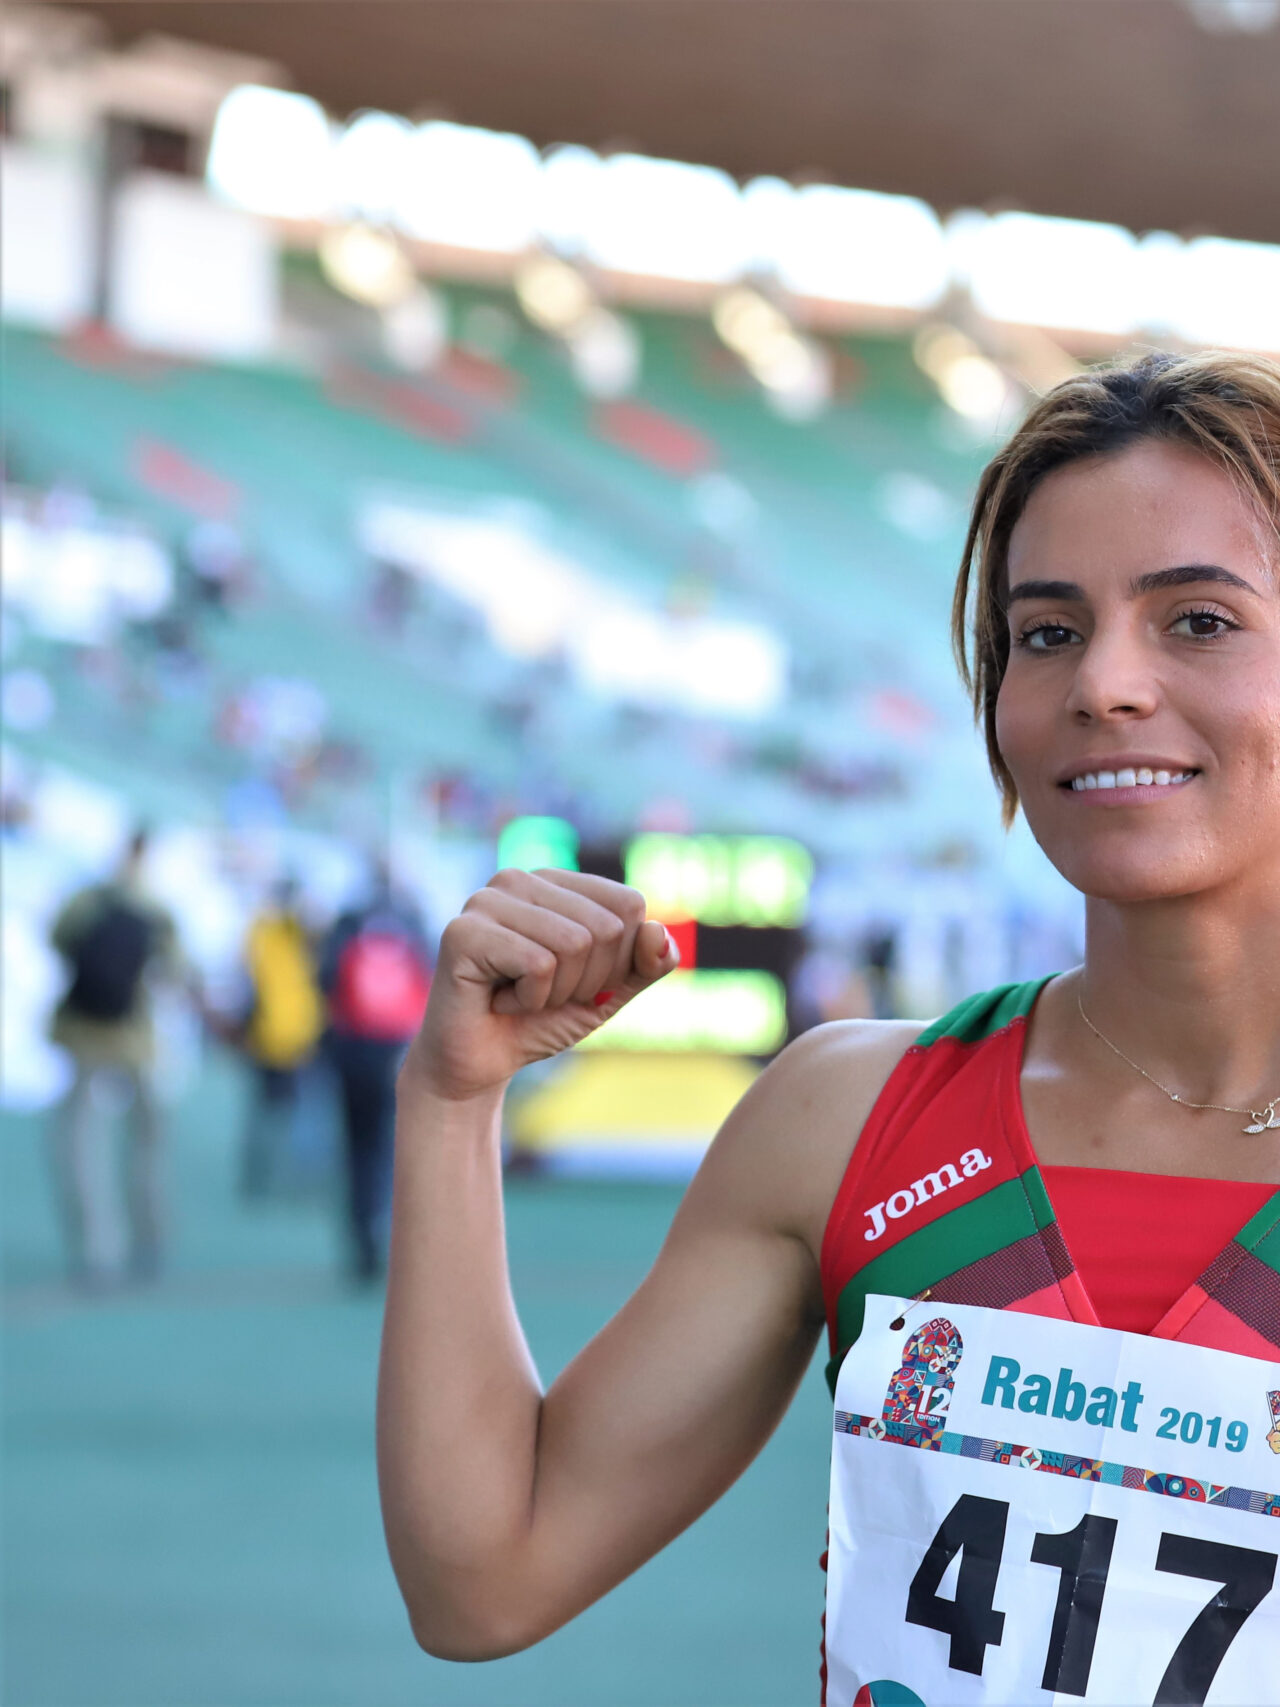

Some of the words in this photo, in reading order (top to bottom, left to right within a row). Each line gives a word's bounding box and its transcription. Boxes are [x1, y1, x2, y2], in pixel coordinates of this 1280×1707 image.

[864, 1148, 992, 1241] Joma
[917, 1384, 952, 1417] 12
[980, 1355, 1145, 1433] Rabat
[1155, 1407, 1249, 1453] 2019
[904, 1493, 1279, 1707] 417
